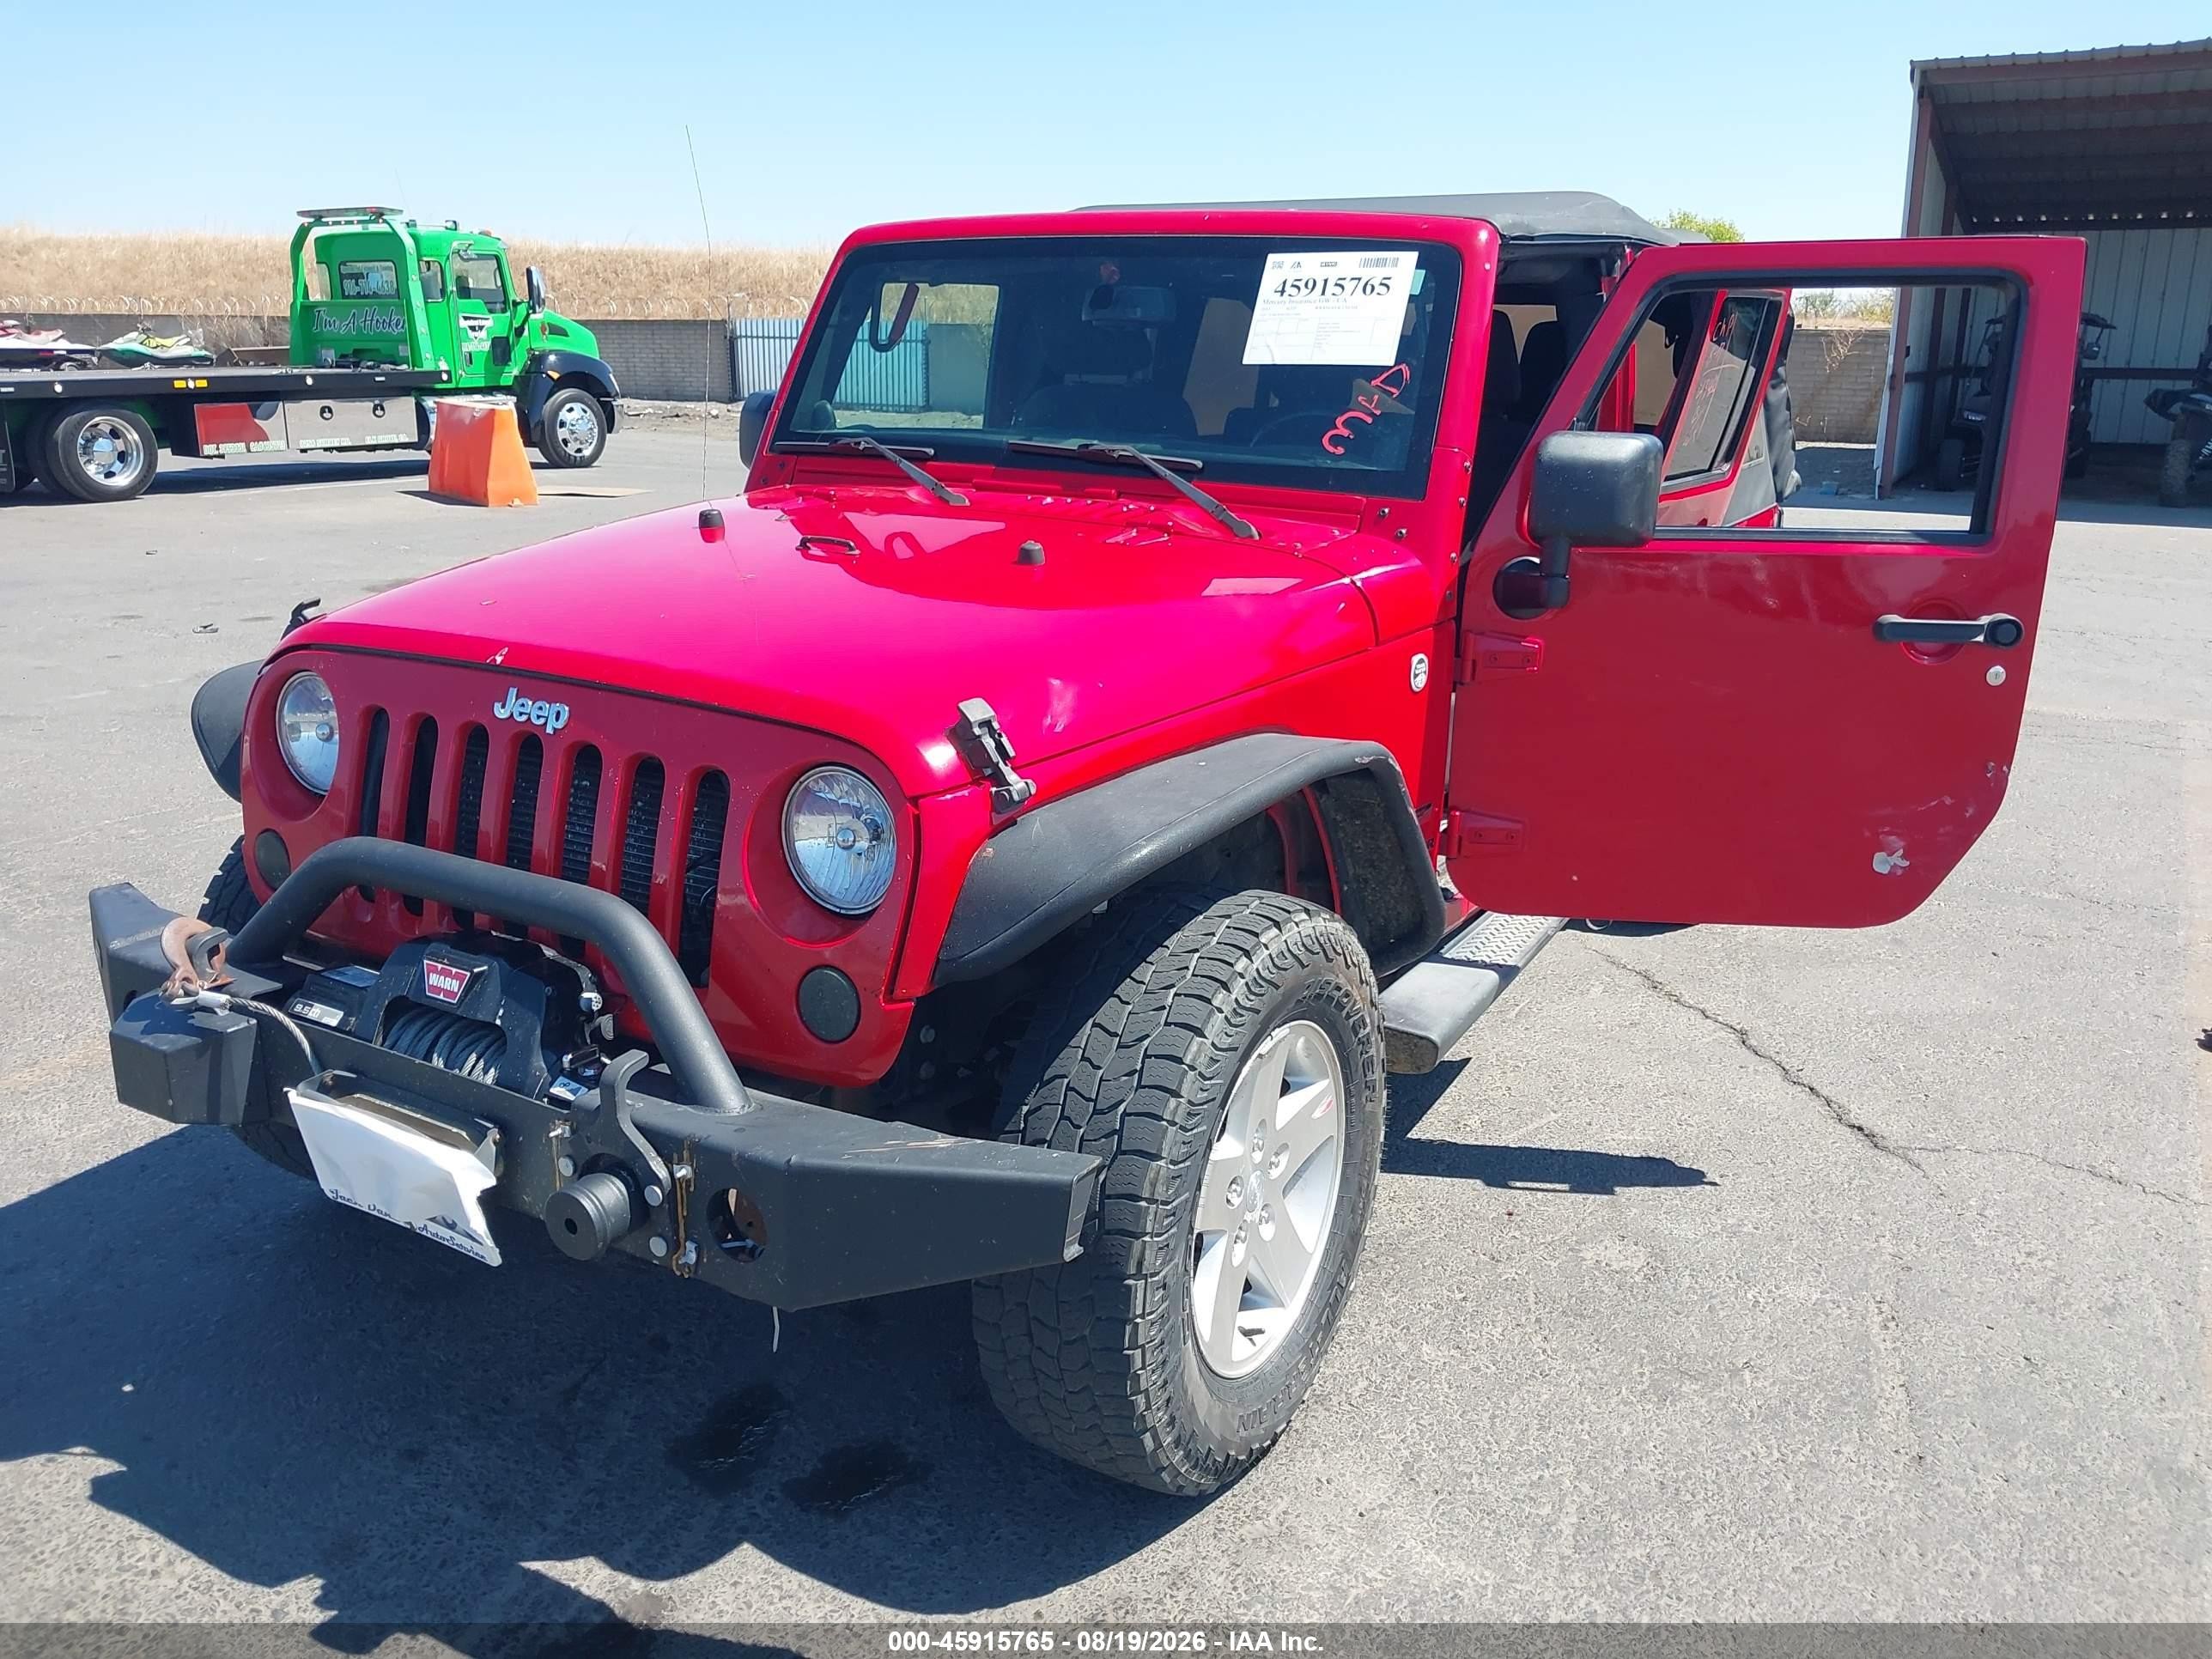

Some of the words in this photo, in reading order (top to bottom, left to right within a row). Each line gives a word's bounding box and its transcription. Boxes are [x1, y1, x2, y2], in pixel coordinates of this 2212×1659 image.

[1274, 276, 1392, 297] 45915765
[339, 309, 357, 335] A
[494, 687, 569, 735] Jeep
[428, 972, 460, 993] WARN
